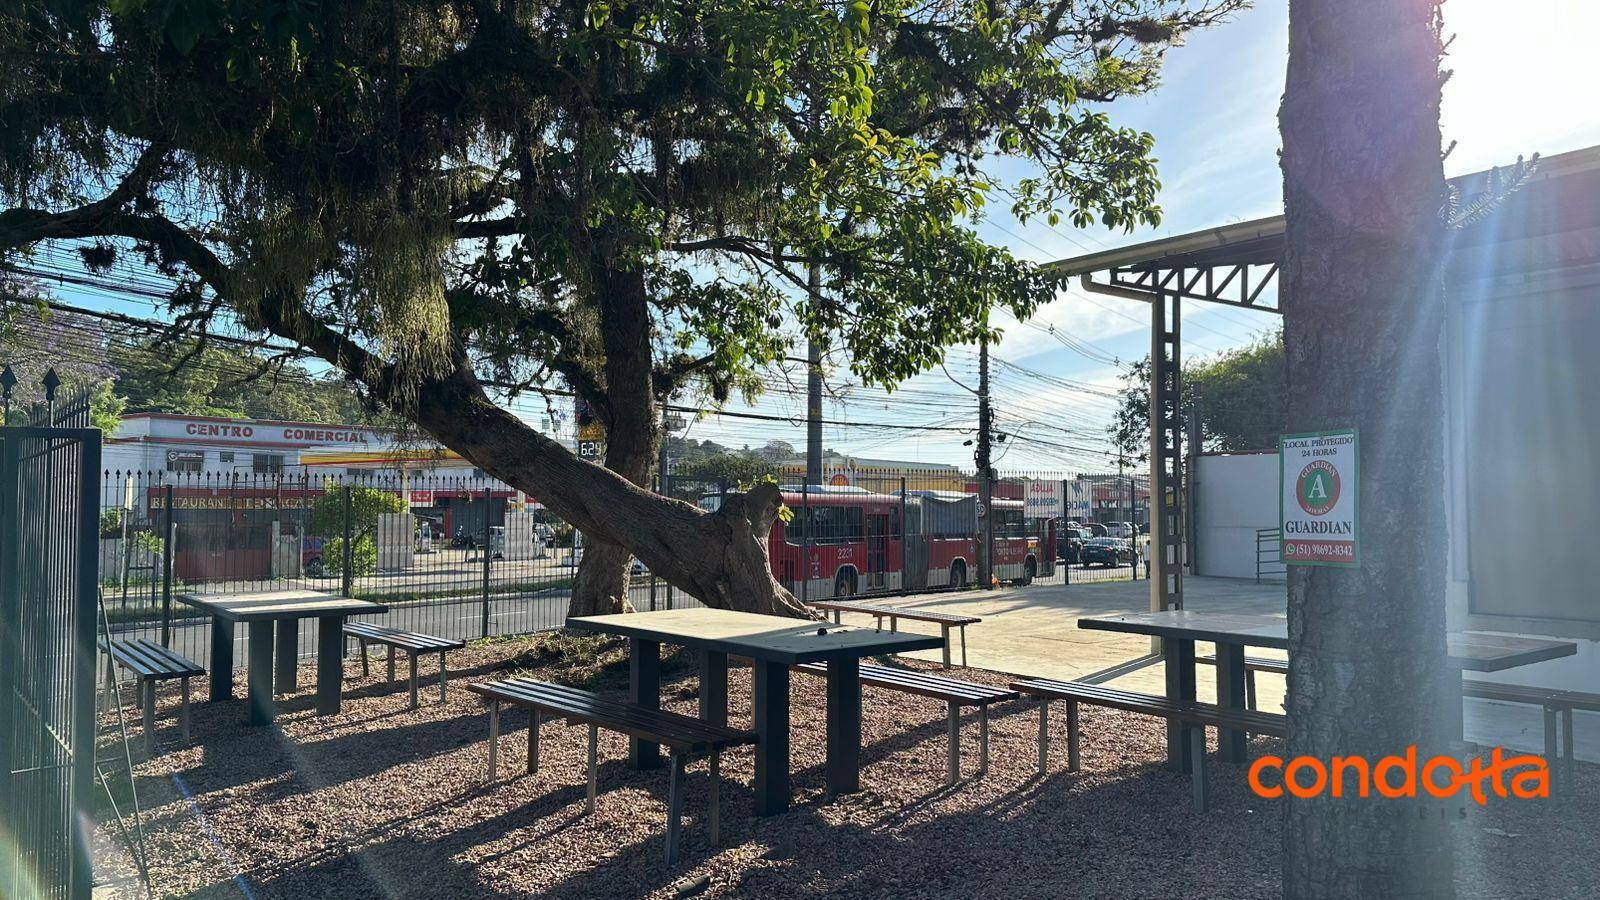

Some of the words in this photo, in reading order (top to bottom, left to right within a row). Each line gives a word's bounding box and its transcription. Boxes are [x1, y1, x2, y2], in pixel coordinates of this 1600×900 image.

[186, 423, 253, 437] CENTRO
[283, 429, 367, 443] COMERCIAL
[1285, 441, 1309, 449] LOCAL
[1311, 437, 1353, 447] PROTEGIDO
[1312, 448, 1337, 456] HORAS
[1301, 461, 1338, 479] GUARDIAN
[1308, 474, 1327, 498] A
[1285, 521, 1352, 534] GUARDIAN
[1296, 543, 1311, 556] (51)
[1312, 544, 1353, 556] 98692-8342
